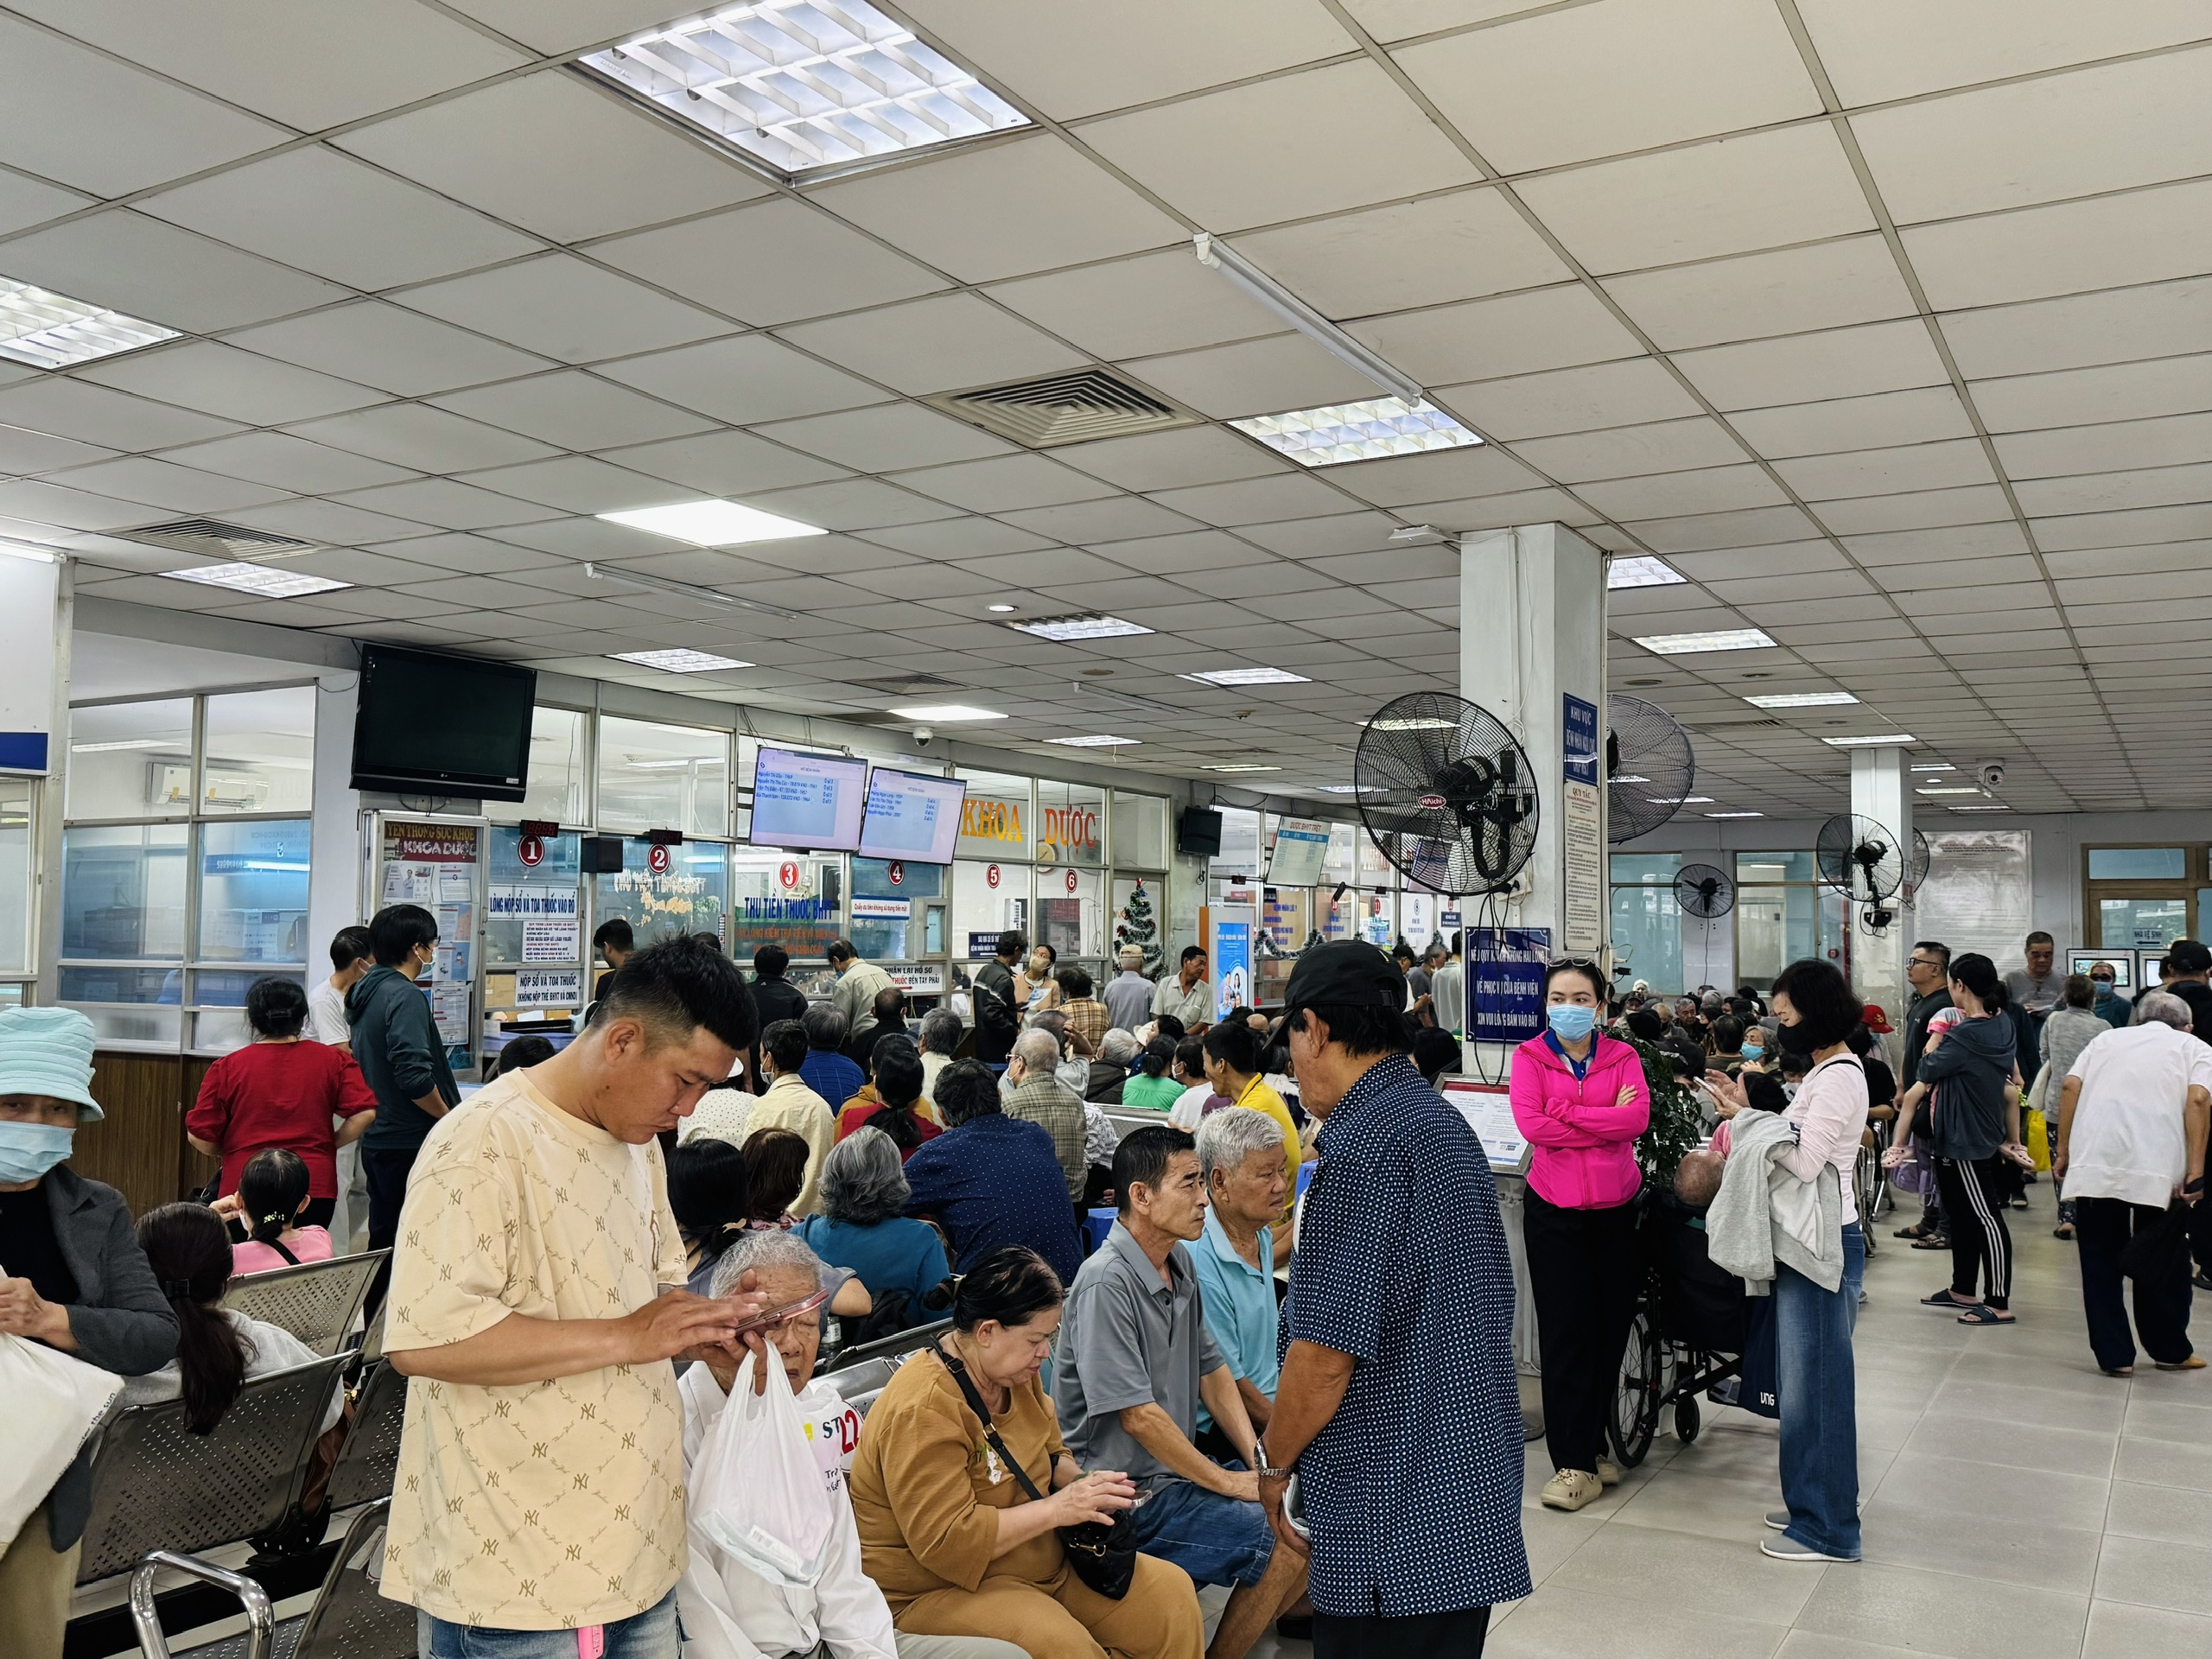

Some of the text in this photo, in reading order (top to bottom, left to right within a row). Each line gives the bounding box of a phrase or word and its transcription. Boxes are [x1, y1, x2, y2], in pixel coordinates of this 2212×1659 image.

[962, 798, 1023, 842] KHOA
[1045, 804, 1096, 855] DƯỢC
[403, 840, 442, 855] KHOA
[527, 841, 538, 860] 1
[654, 849, 665, 867] 2
[785, 865, 795, 885] 3
[893, 866, 901, 880] 4
[990, 869, 997, 880] 5
[1069, 875, 1075, 887] 6
[531, 897, 541, 913] TOA
[744, 897, 761, 918] THU
[763, 888, 783, 919] TIỀN
[784, 890, 811, 920] THUỐC
